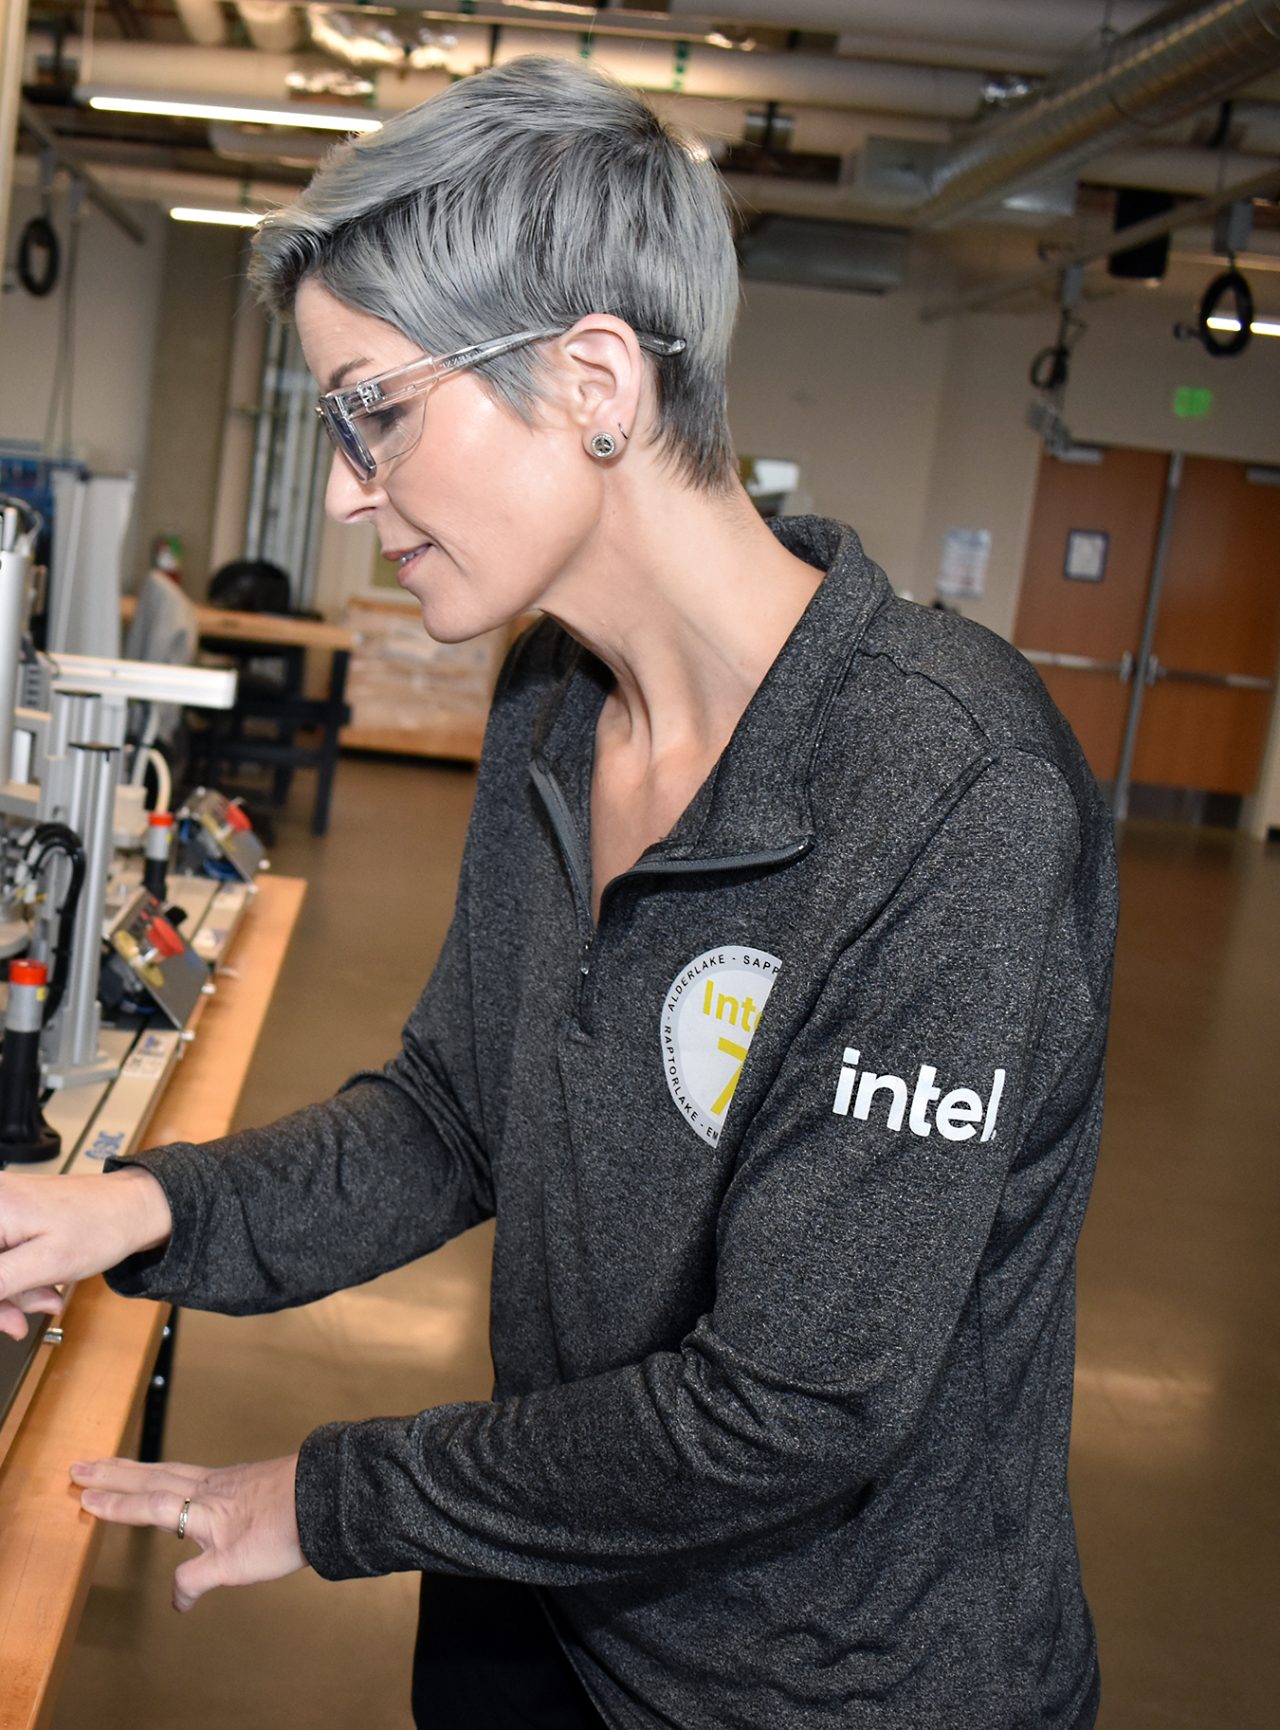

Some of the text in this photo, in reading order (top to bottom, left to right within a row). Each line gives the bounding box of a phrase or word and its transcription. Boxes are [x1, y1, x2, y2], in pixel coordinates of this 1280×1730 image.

[668, 953, 726, 1013] ALDERLAKE
[743, 954, 781, 976] SAPP
[703, 979, 764, 1033] Int
[664, 1025, 699, 1122] RAPTORLAKE
[833, 1047, 1005, 1142] intel
